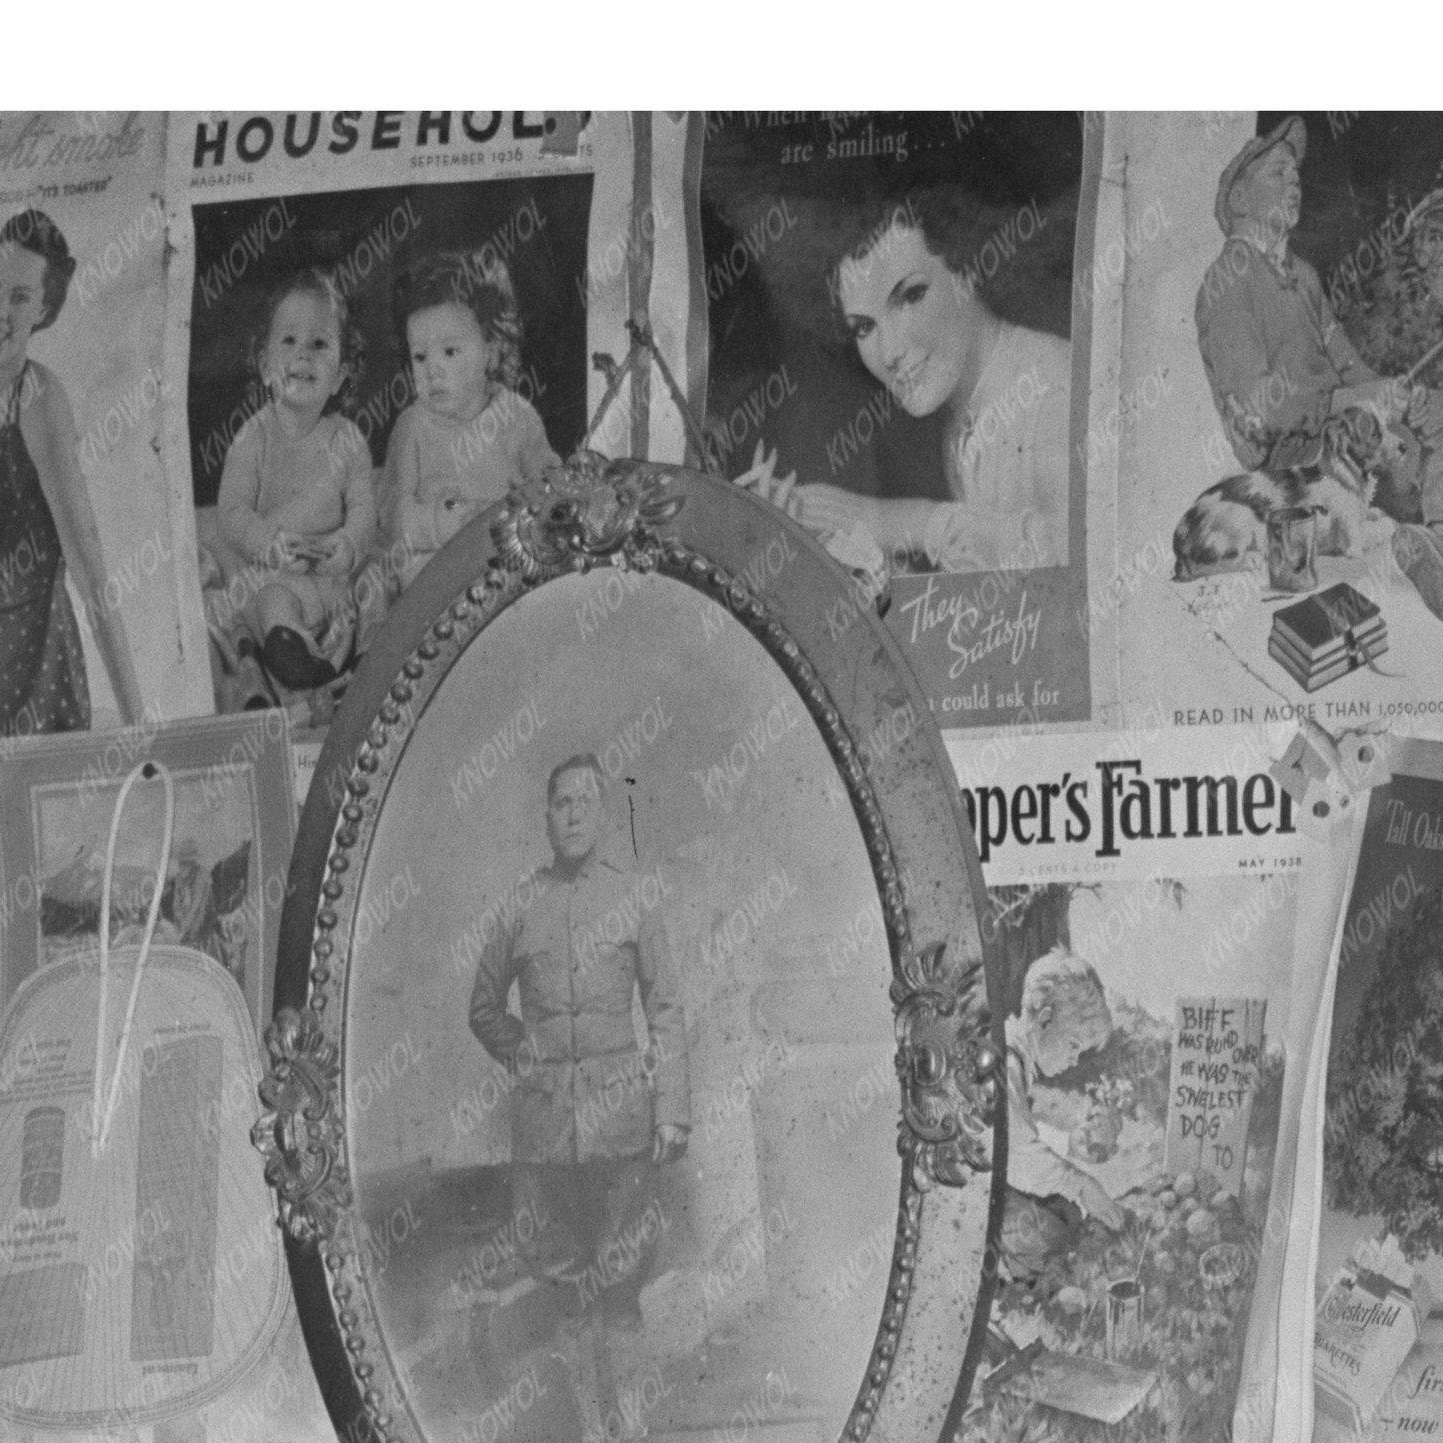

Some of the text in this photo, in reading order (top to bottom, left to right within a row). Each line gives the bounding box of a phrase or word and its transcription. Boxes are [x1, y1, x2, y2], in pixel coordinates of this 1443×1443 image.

[193, 111, 592, 168] HOUSEHOL
[410, 154, 485, 169] SEPTEMBER
[492, 147, 523, 165] 1936
[780, 143, 814, 164] are
[190, 172, 254, 188] MAGAZINE
[901, 577, 962, 643] They
[947, 591, 1041, 679] Satisfy
[942, 683, 991, 712] could
[997, 682, 1025, 709] ask
[1031, 680, 1061, 706] for
[1174, 708, 1224, 727] READ
[1234, 706, 1253, 724] IN
[1264, 703, 1316, 723] MORE
[1326, 701, 1370, 720] THAN
[1239, 858, 1265, 869] MAY
[1182, 1005, 1235, 1032] BIFF
[1178, 1031, 1204, 1050] WAS
[1181, 1060, 1195, 1076] HE
[1198, 1063, 1229, 1084] WAS
[1180, 1114, 1220, 1139] DOG
[1213, 1144, 1233, 1170] TO
